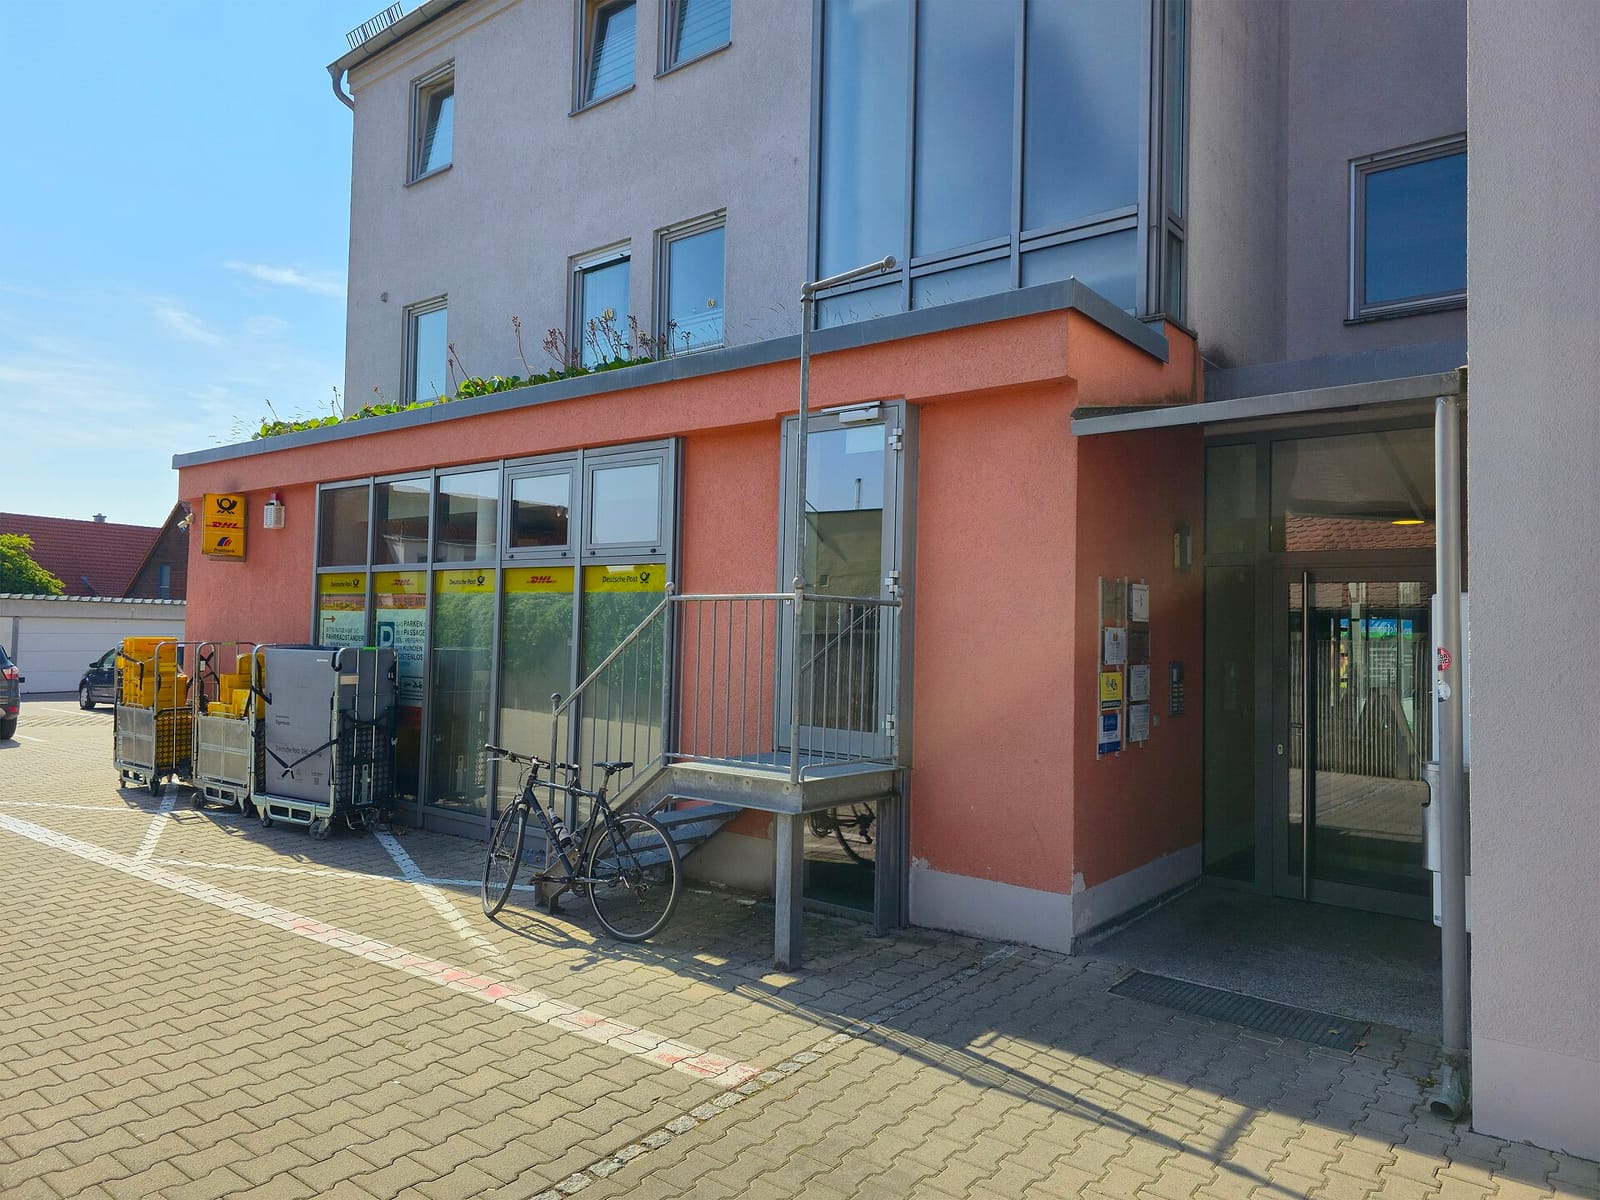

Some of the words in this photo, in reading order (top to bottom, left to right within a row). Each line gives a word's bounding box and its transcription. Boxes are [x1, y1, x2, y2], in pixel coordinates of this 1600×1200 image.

[211, 521, 240, 529] DHL
[528, 576, 553, 584] DHL
[603, 575, 626, 583] Deutsche
[626, 575, 638, 583] Post
[403, 620, 423, 628] PARKEN
[403, 629, 425, 637] PASSAGE
